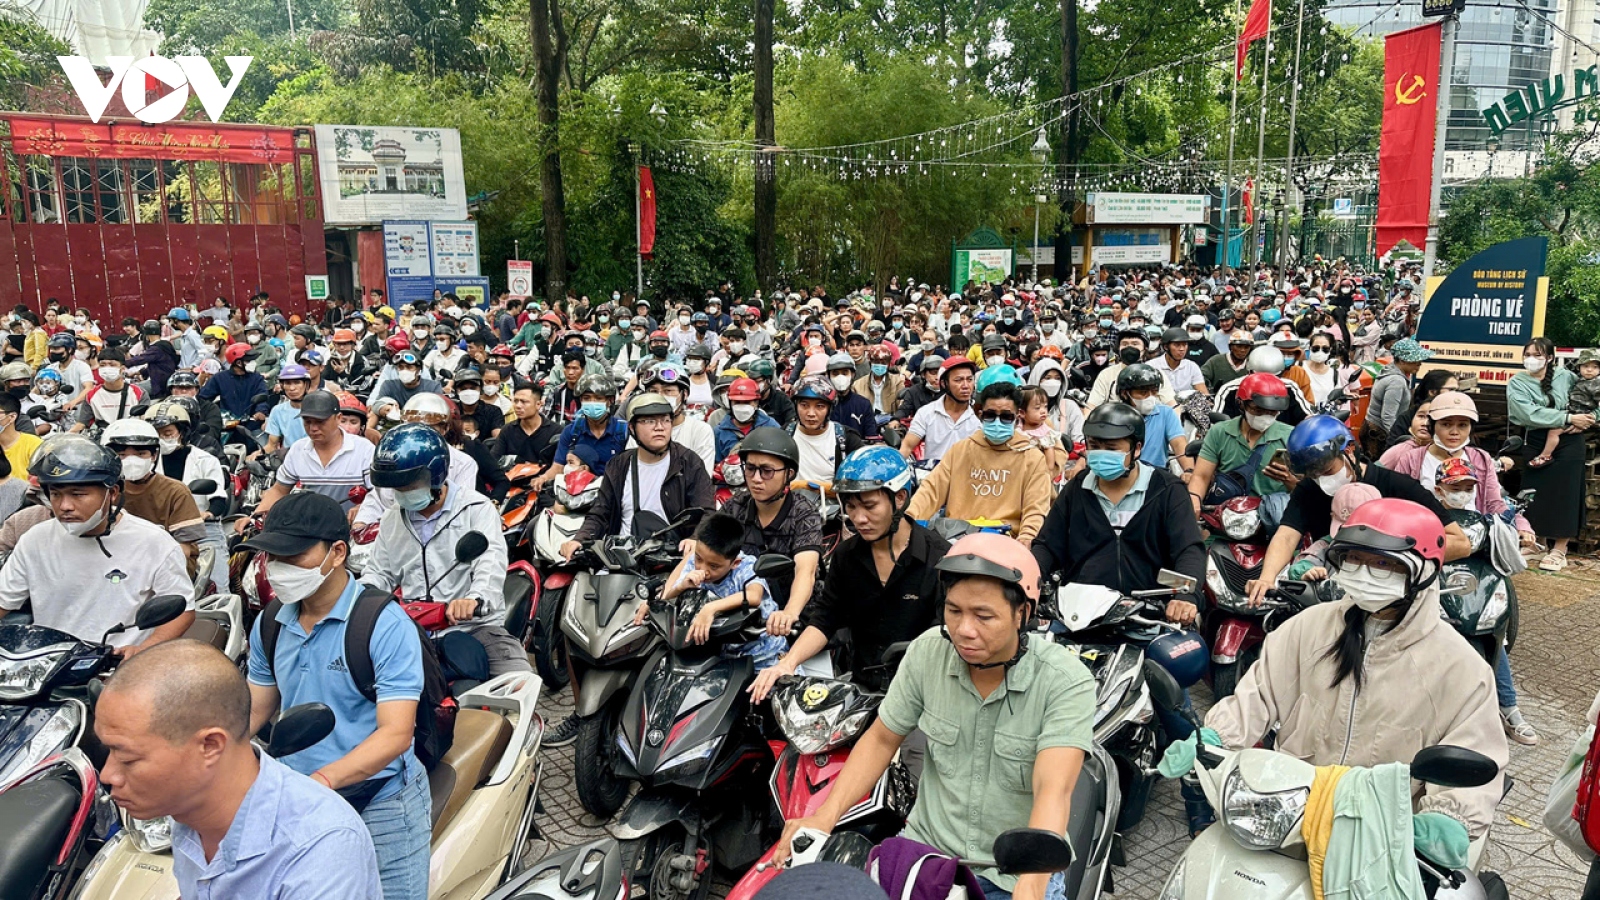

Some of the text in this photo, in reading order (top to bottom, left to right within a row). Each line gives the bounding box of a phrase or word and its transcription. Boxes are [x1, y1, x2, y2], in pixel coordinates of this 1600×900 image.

[1486, 269, 1501, 279] TÀNG
[1503, 270, 1516, 280] LỊCH
[1451, 294, 1524, 318] PHÒNG VÉ
[1489, 321, 1522, 336] TICKET
[971, 468, 1010, 482] WANT
[971, 483, 1003, 497] YOU
[1234, 870, 1266, 886] HONDA
